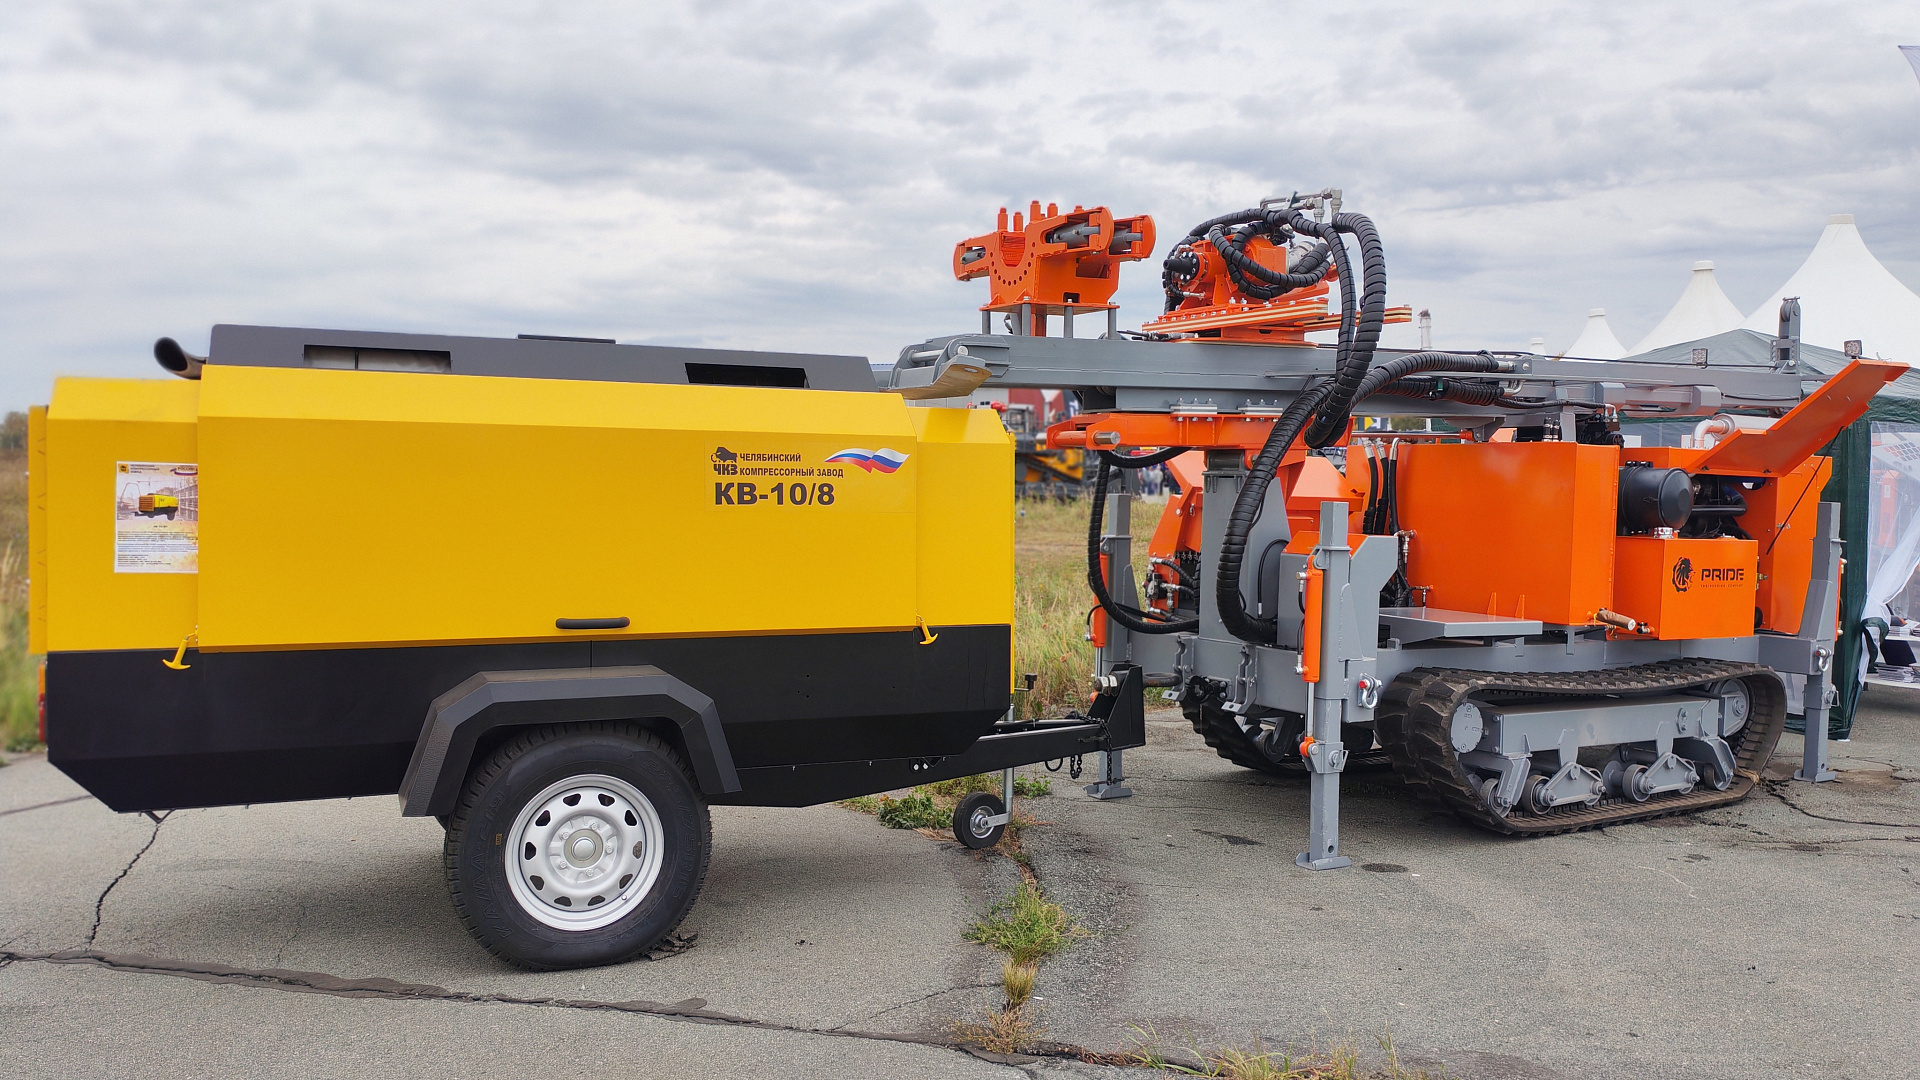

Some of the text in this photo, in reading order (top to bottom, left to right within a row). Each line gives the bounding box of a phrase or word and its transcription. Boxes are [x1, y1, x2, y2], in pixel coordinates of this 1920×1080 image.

[740, 453, 801, 462] ЧЕЛЯБИНСКИЙ
[713, 463, 738, 476] ЧКЗ
[740, 467, 844, 478] КОМПРЕССОРНЫЙ ЗАВОД
[714, 482, 835, 506] КВ-10/8
[1701, 568, 1744, 581] PRIDE
